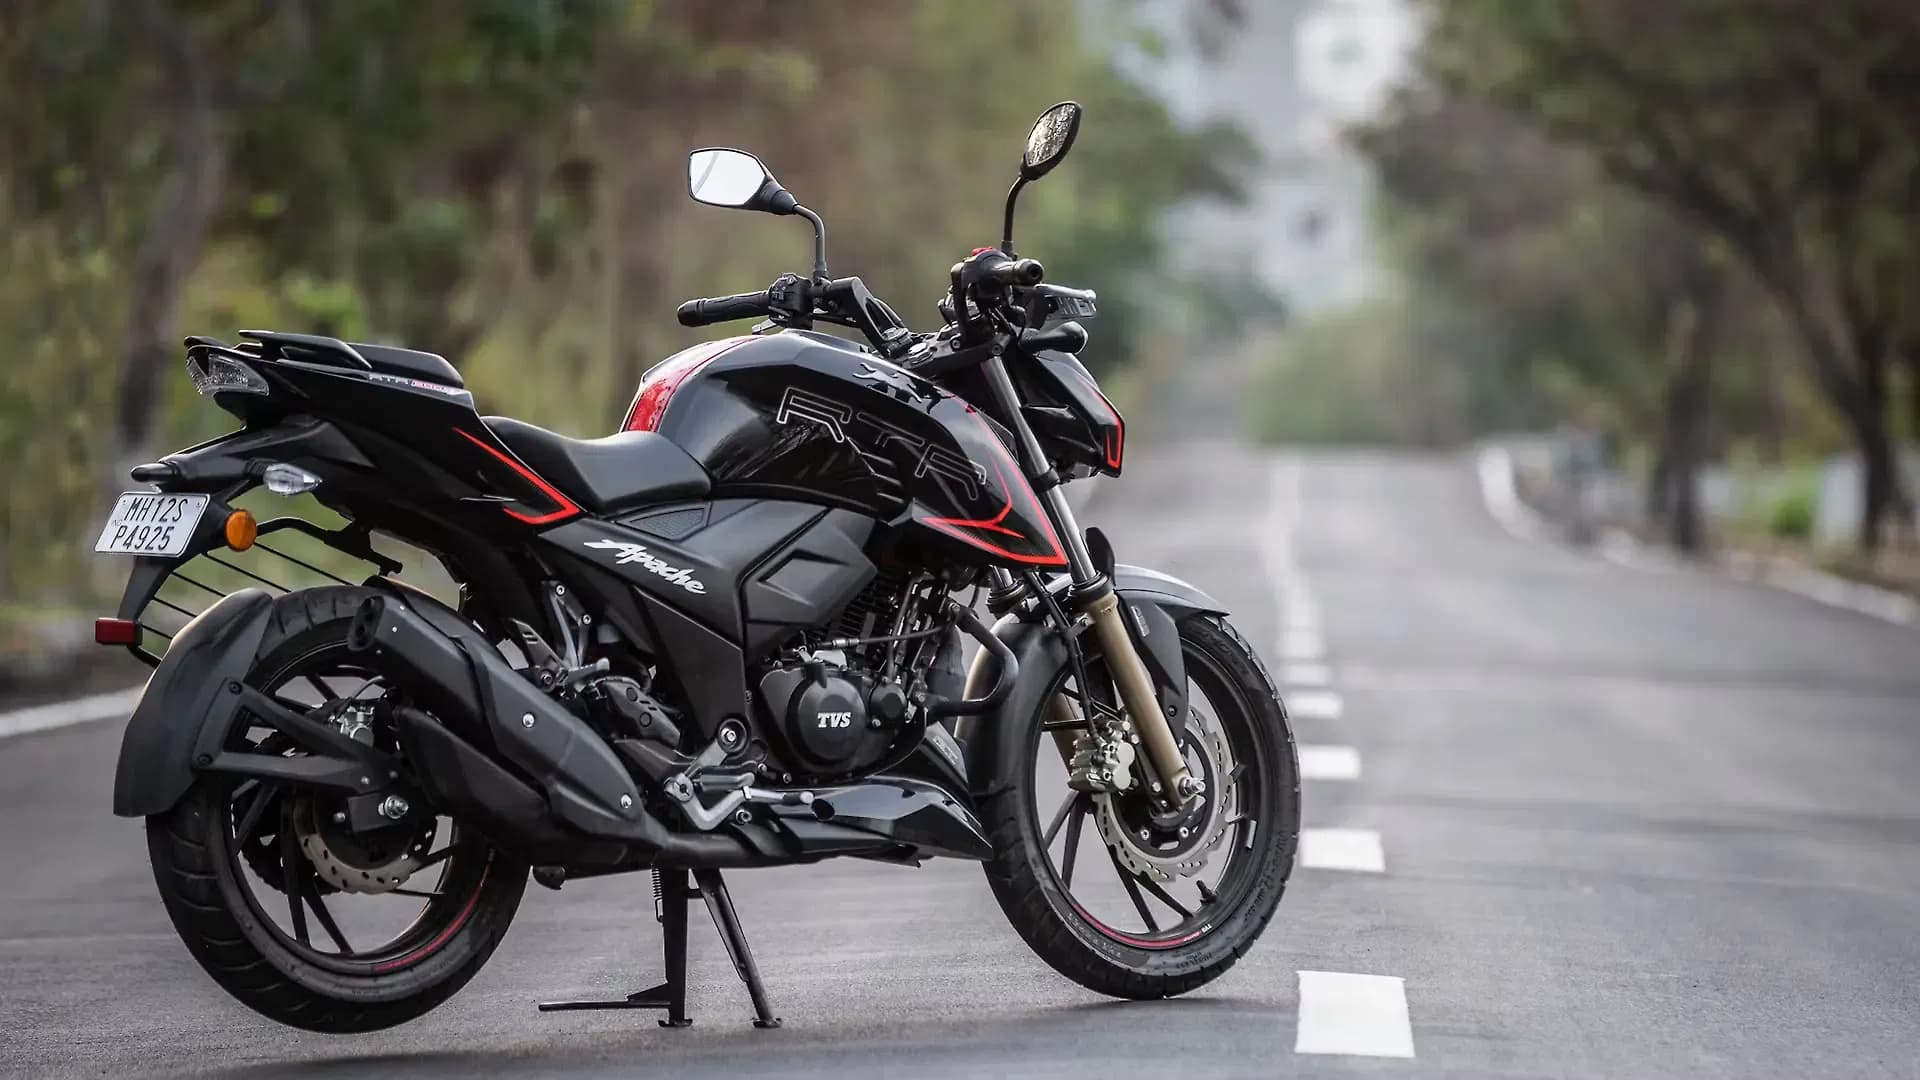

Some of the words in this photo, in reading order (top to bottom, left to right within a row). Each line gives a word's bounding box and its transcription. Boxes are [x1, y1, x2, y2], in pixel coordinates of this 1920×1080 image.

[776, 386, 987, 500] RTR
[123, 497, 188, 522] MH12S
[110, 525, 175, 551] P4925
[583, 539, 707, 594] Apache
[817, 711, 851, 728] TVS
